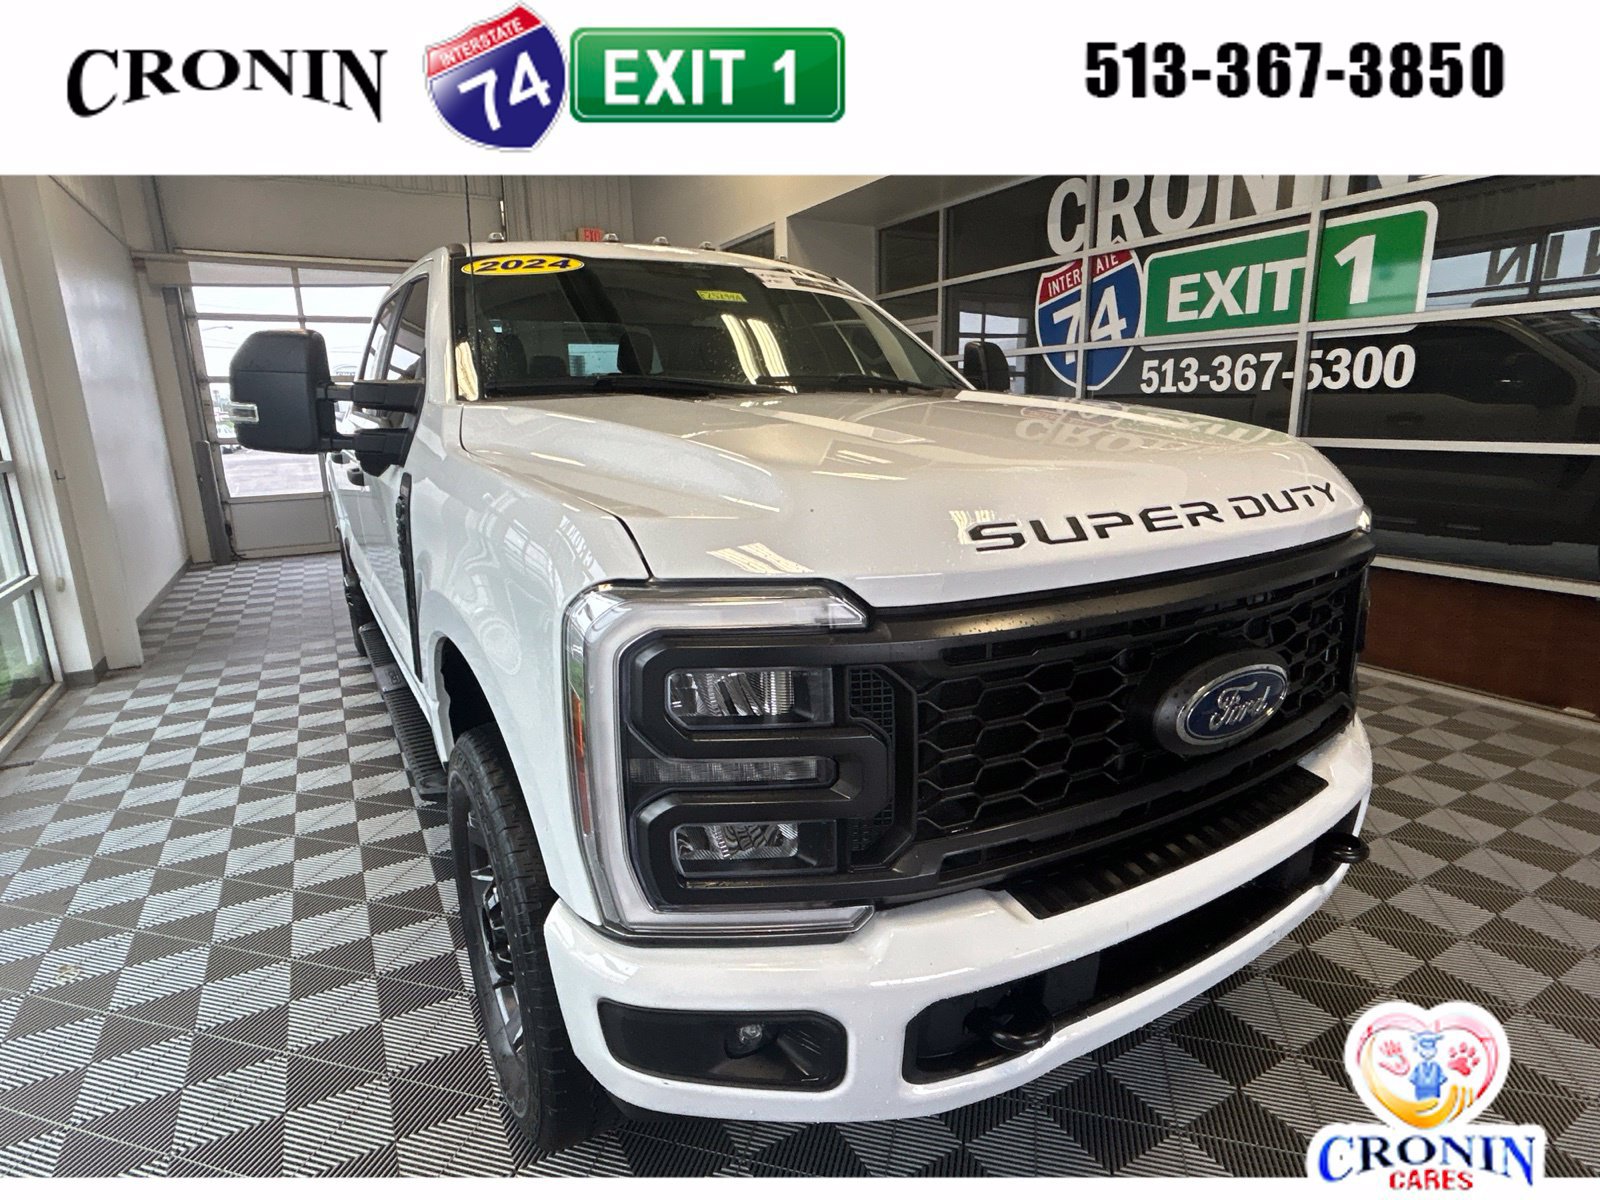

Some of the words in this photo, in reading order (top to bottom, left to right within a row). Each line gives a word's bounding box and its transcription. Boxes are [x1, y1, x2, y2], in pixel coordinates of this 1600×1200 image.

[475, 258, 571, 273] 2024
[1048, 253, 1119, 297] INTERATE
[1167, 257, 1307, 322] EXIT
[1334, 234, 1376, 305] 1
[1053, 286, 1127, 365] 74
[1140, 344, 1416, 394] 513-367-5300
[968, 501, 1224, 552] SUPER
[1228, 482, 1336, 520] DUTY
[1209, 681, 1271, 731] Ford
